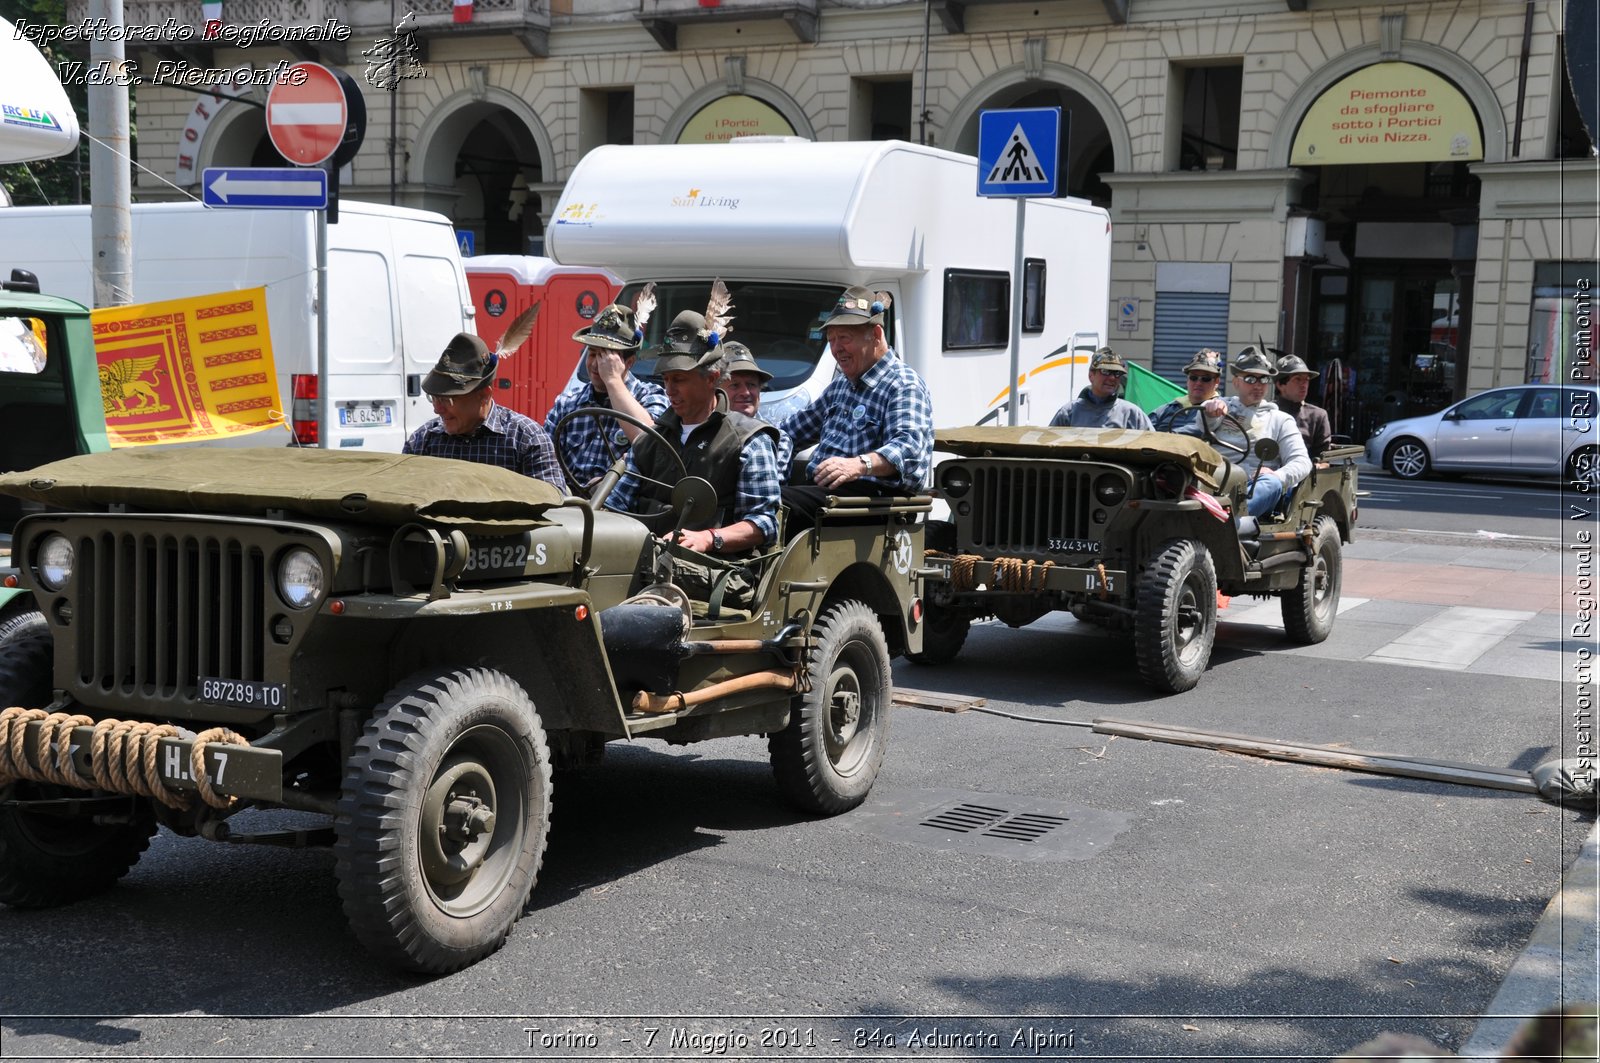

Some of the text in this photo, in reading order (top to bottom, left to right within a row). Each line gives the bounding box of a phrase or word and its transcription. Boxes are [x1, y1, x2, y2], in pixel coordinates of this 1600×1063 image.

[1350, 88, 1427, 101] Piemonte
[1340, 102, 1436, 117] da sfogliare
[721, 118, 760, 129] Portici
[1331, 120, 1374, 131] sotto
[1387, 116, 1443, 128] Portici
[704, 131, 715, 141] di
[717, 131, 733, 141] via
[1339, 131, 1432, 145] di via Nizza.
[671, 196, 740, 210] Sun Living
[346, 409, 358, 423] BL
[505, 600, 513, 610] 35
[203, 680, 280, 706] 687289 TO
